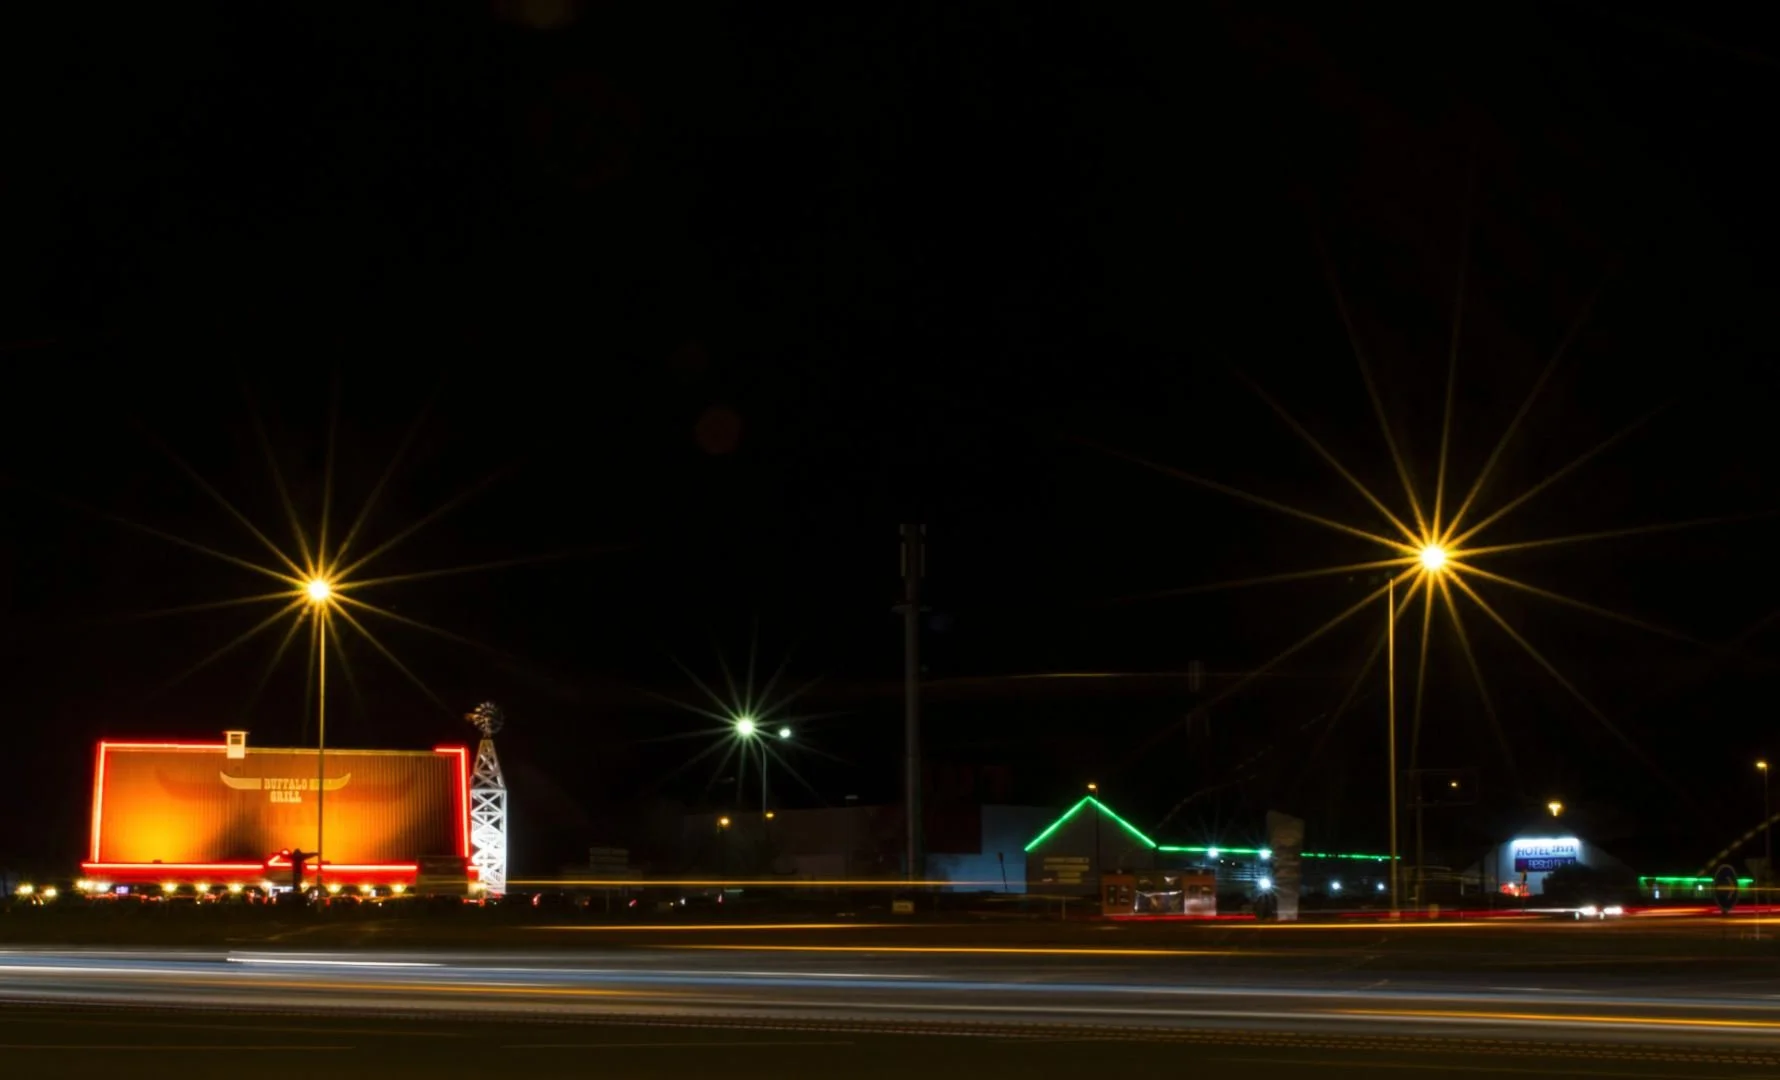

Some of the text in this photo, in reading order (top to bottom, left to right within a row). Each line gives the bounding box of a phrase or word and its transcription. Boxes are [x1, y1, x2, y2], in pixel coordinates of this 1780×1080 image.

[264, 778, 307, 790] BUFFALO
[270, 790, 302, 803] GRILL
[1516, 846, 1550, 857] HOTEL
